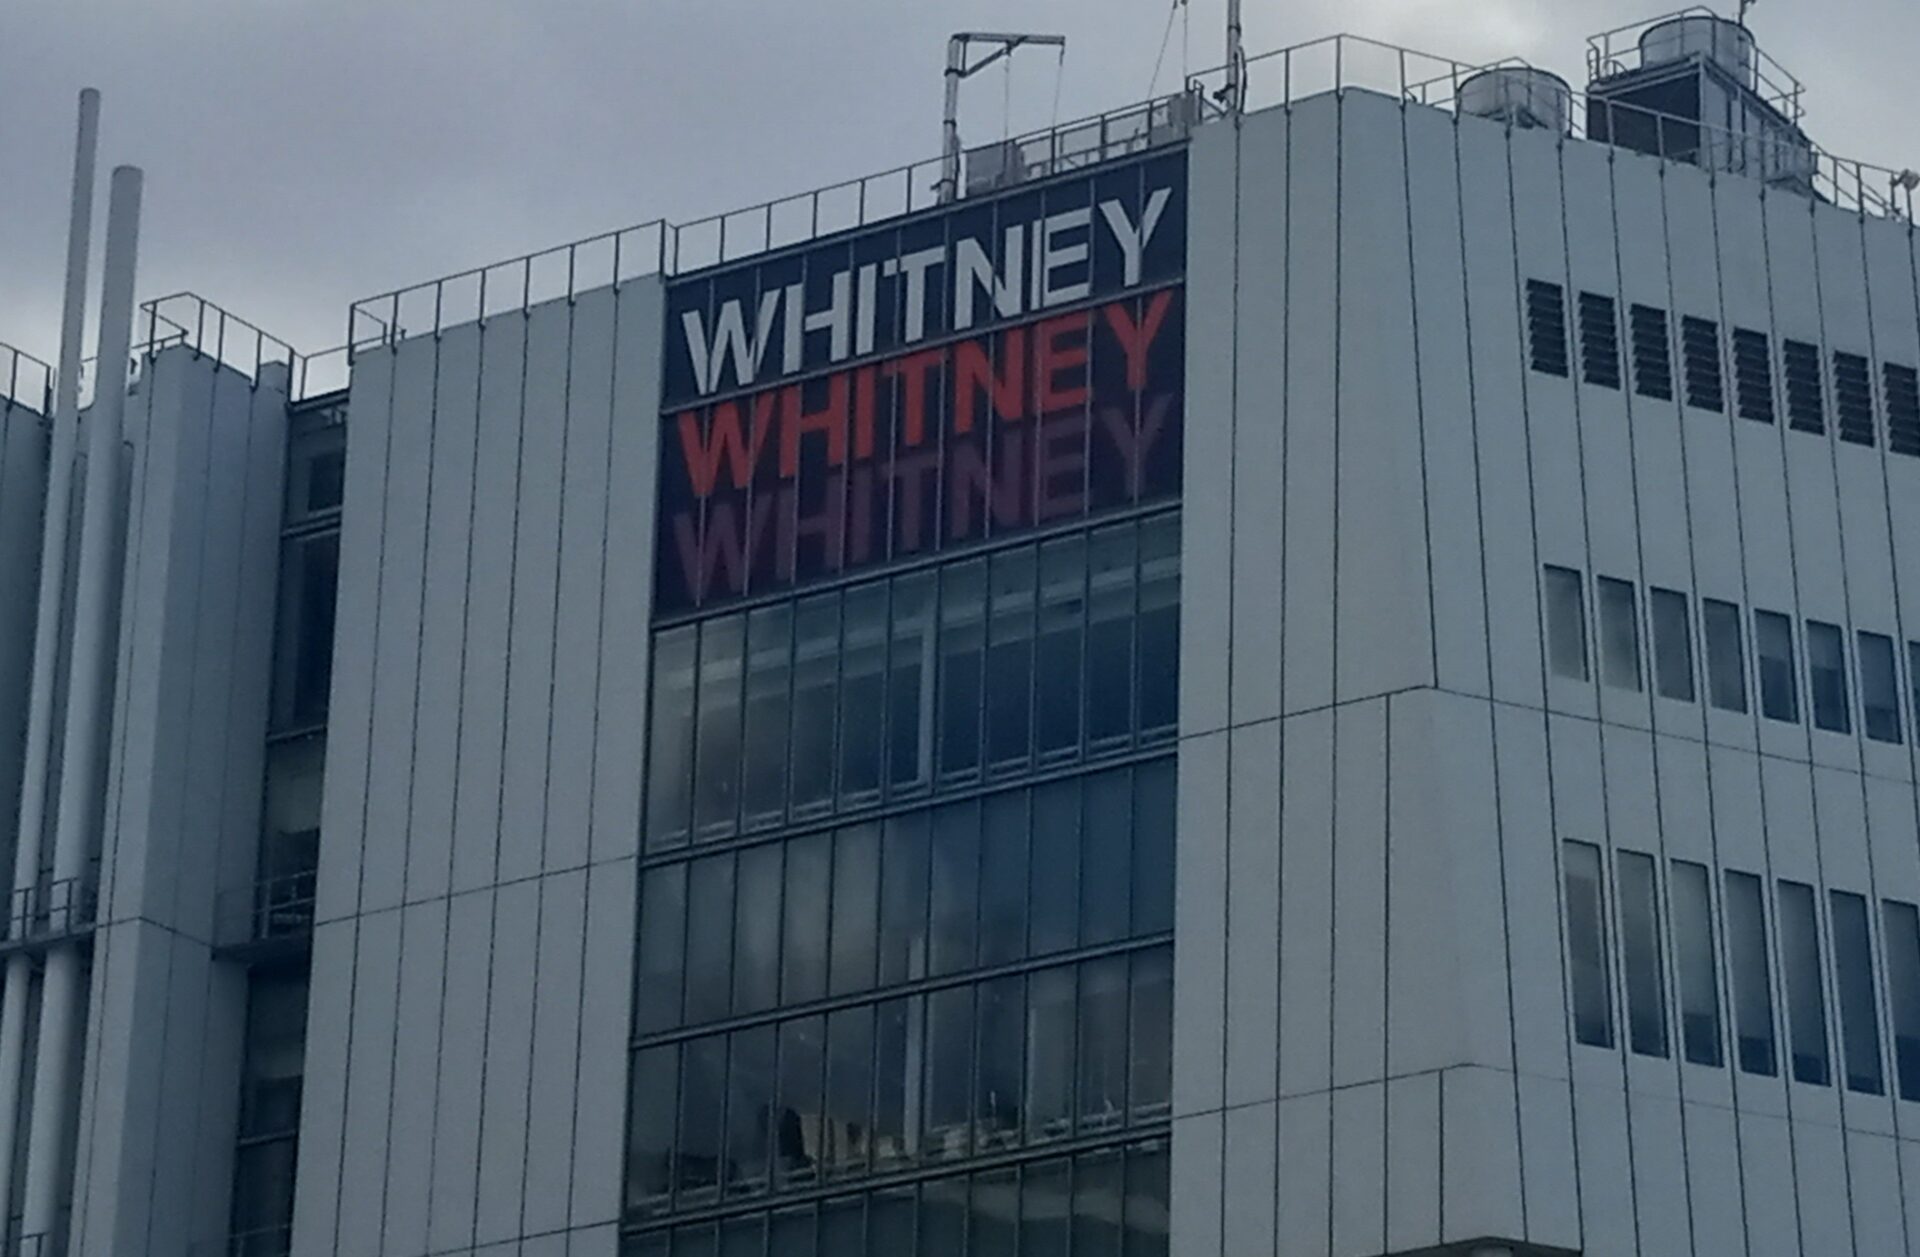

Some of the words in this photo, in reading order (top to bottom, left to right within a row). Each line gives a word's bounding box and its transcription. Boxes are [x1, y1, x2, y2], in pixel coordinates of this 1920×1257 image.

[677, 290, 1173, 497] WHITNEY
[682, 187, 1173, 395] WHITNEY
[673, 392, 1174, 605] WHITNEY
